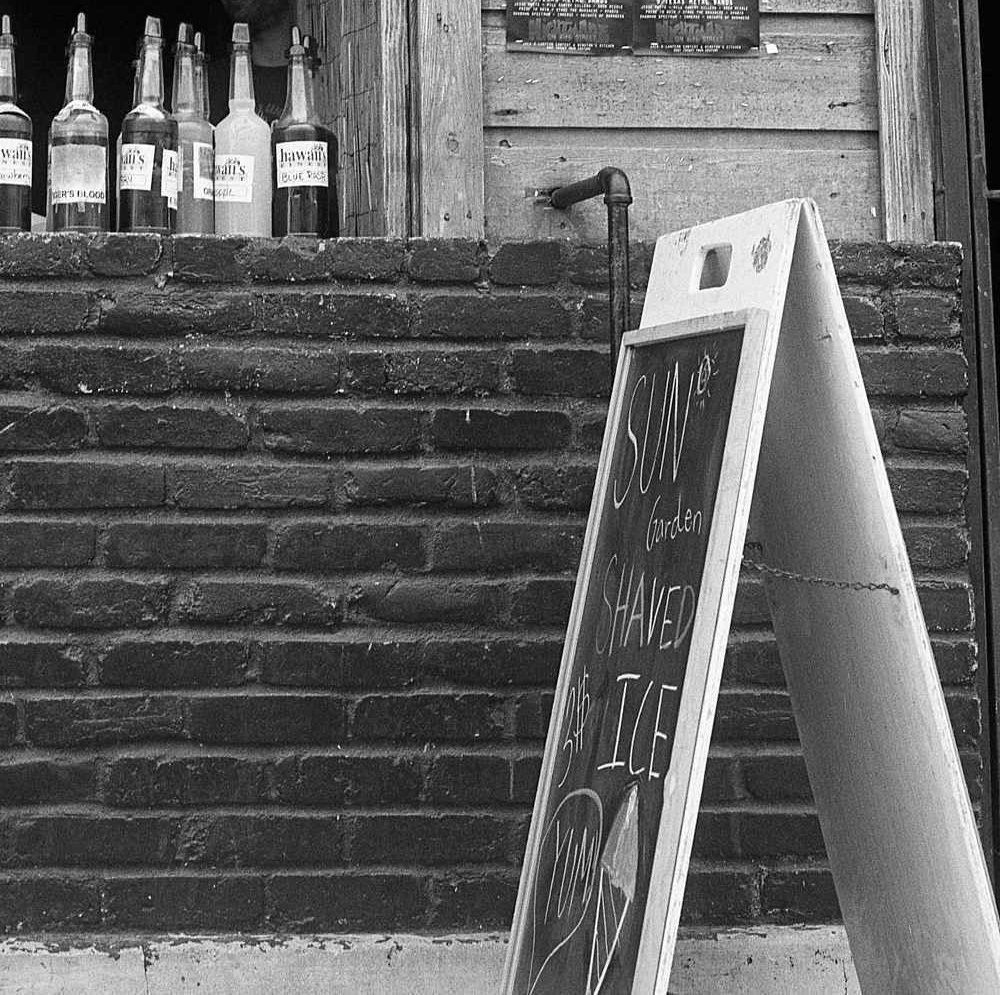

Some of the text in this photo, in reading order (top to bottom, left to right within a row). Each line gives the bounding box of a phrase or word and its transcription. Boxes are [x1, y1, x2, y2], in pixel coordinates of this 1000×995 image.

[77, 190, 105, 200] BLOOD
[282, 173, 304, 183] BLUE
[614, 361, 695, 509] SUN
[646, 494, 702, 552] Garden
[596, 554, 695, 657] SHAVED
[597, 673, 678, 782] ICE
